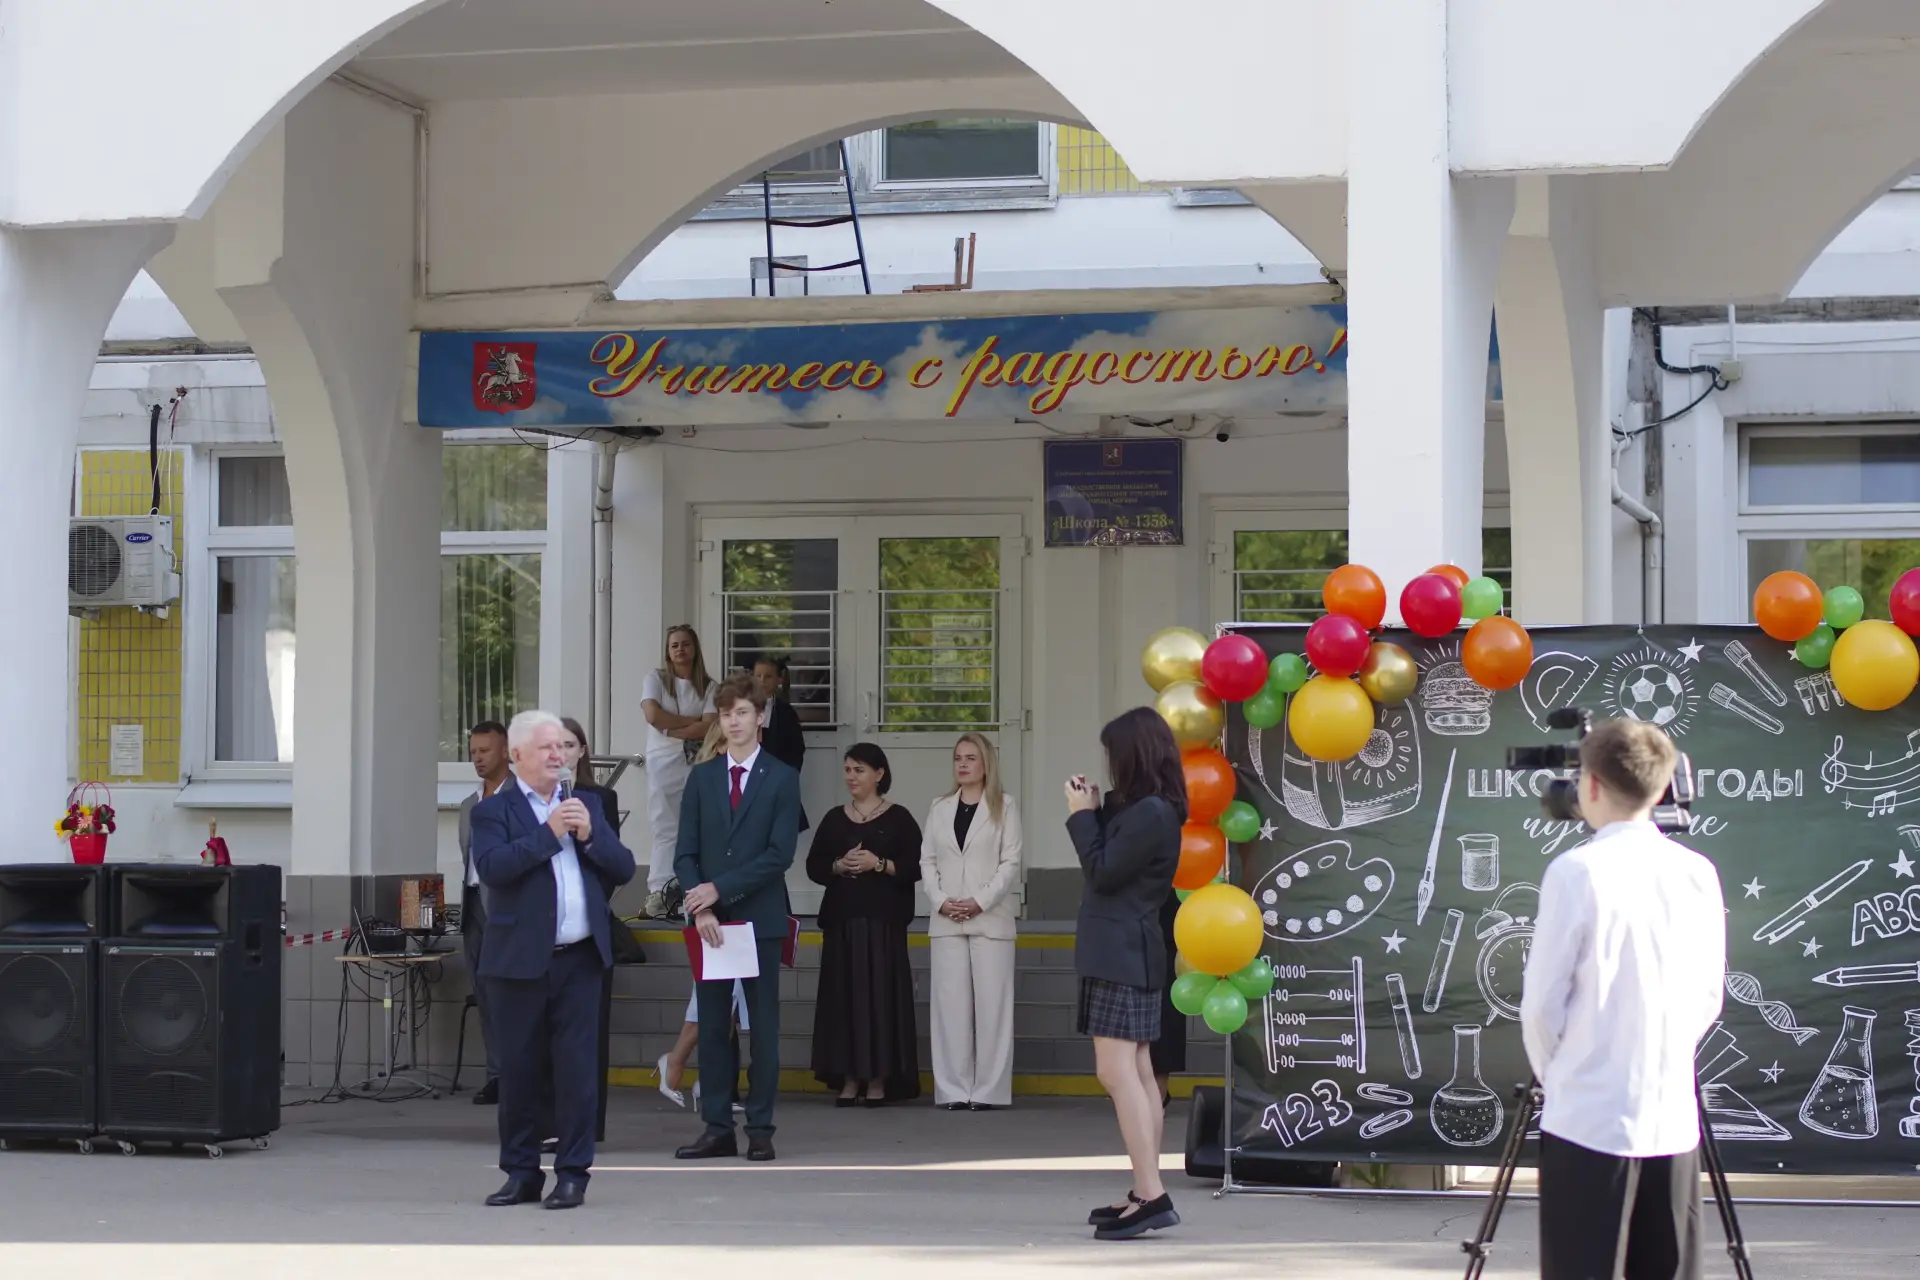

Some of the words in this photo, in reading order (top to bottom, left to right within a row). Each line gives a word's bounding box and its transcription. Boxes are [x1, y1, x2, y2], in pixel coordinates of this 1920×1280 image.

[589, 333, 885, 398] Учитесь
[907, 355, 943, 388] с
[945, 327, 1347, 417] радостью!
[1697, 768, 1804, 802] ГОДЫ
[1519, 938, 1532, 949] 12
[1489, 966, 1496, 977] 9
[1261, 1079, 1353, 1148] 123
